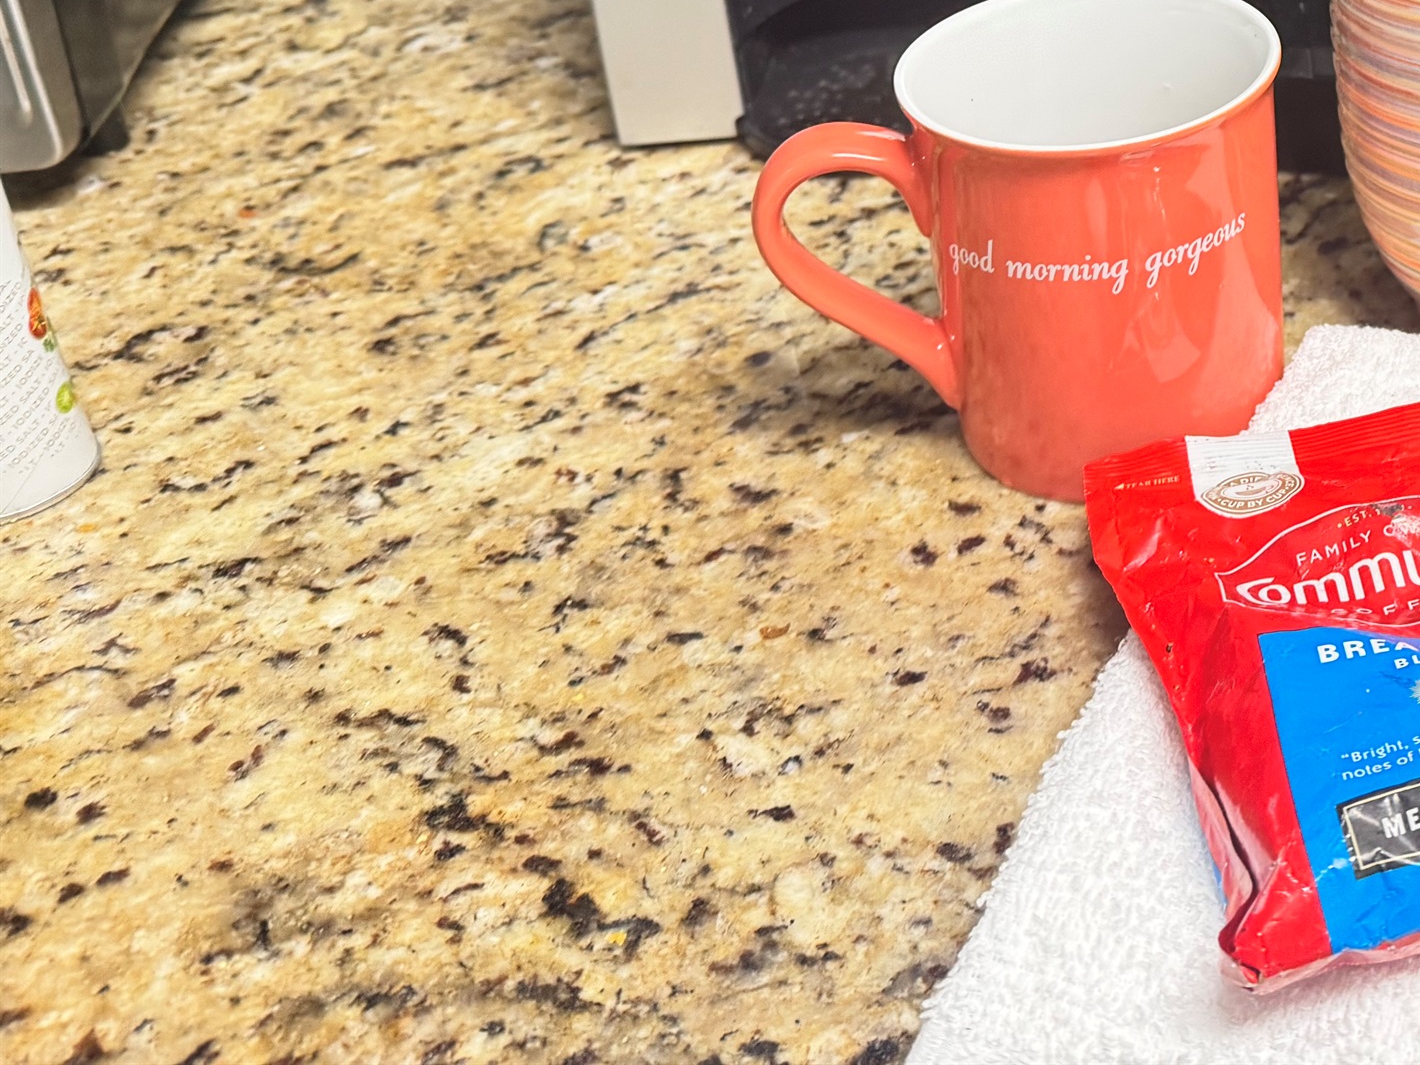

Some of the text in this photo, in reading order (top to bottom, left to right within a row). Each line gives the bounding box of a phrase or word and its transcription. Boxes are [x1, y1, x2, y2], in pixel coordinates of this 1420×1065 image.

[949, 212, 1247, 295] good morning gorgeous
[1220, 489, 1287, 509] CUP BY CUP
[1343, 508, 1373, 527] EST.
[1296, 530, 1372, 567] FAMILY
[1341, 760, 1392, 782] notes
[1396, 751, 1414, 767] of
